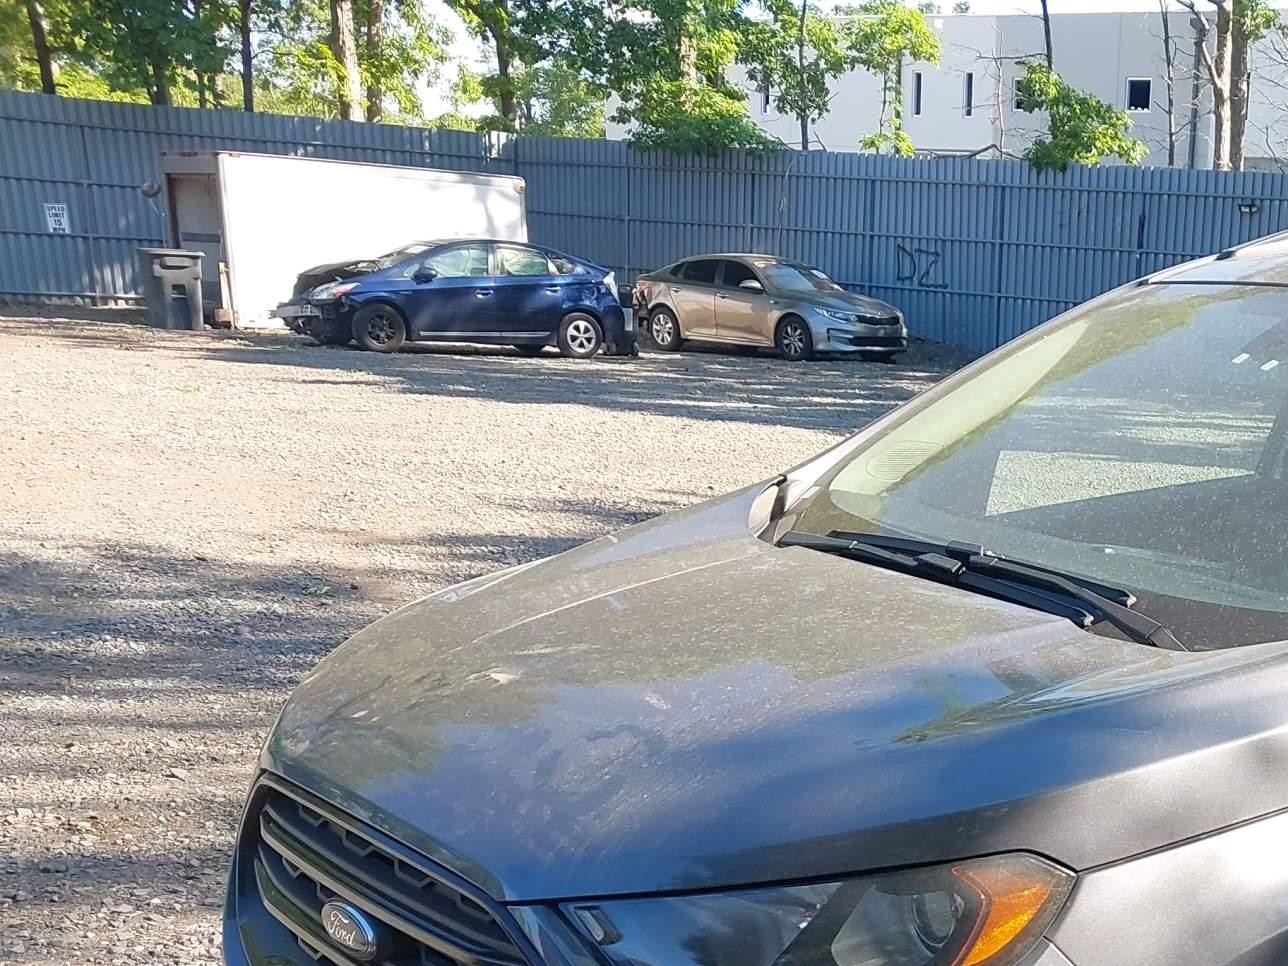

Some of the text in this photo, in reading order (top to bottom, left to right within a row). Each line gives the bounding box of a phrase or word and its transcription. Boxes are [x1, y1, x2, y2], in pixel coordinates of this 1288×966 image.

[54, 218, 63, 226] 15
[896, 243, 949, 290] DZ
[328, 910, 357, 946] Ford
